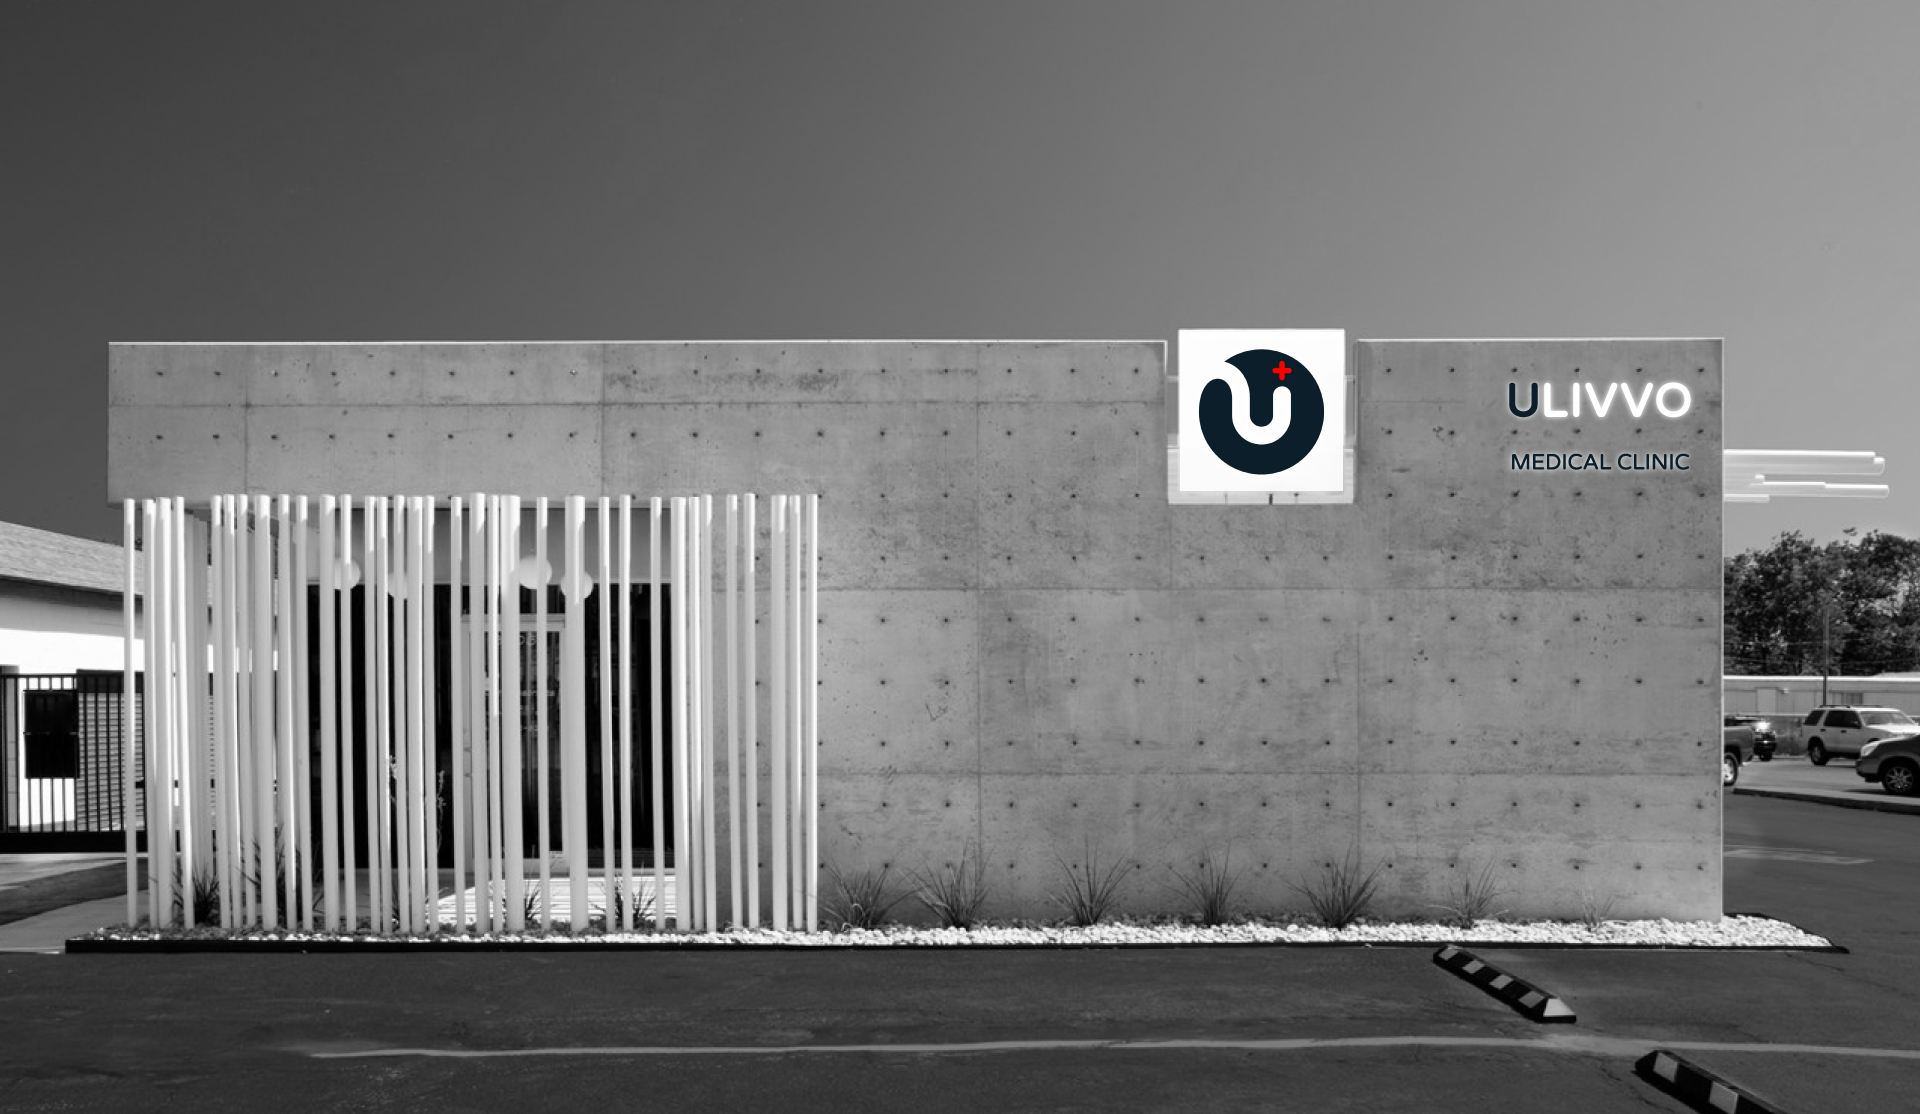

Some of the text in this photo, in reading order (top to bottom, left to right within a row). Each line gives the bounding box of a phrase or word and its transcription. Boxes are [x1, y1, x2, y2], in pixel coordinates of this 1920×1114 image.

[1509, 382, 1691, 418] ULIVVO
[1511, 453, 1690, 470] MEDICAL CLINIC
